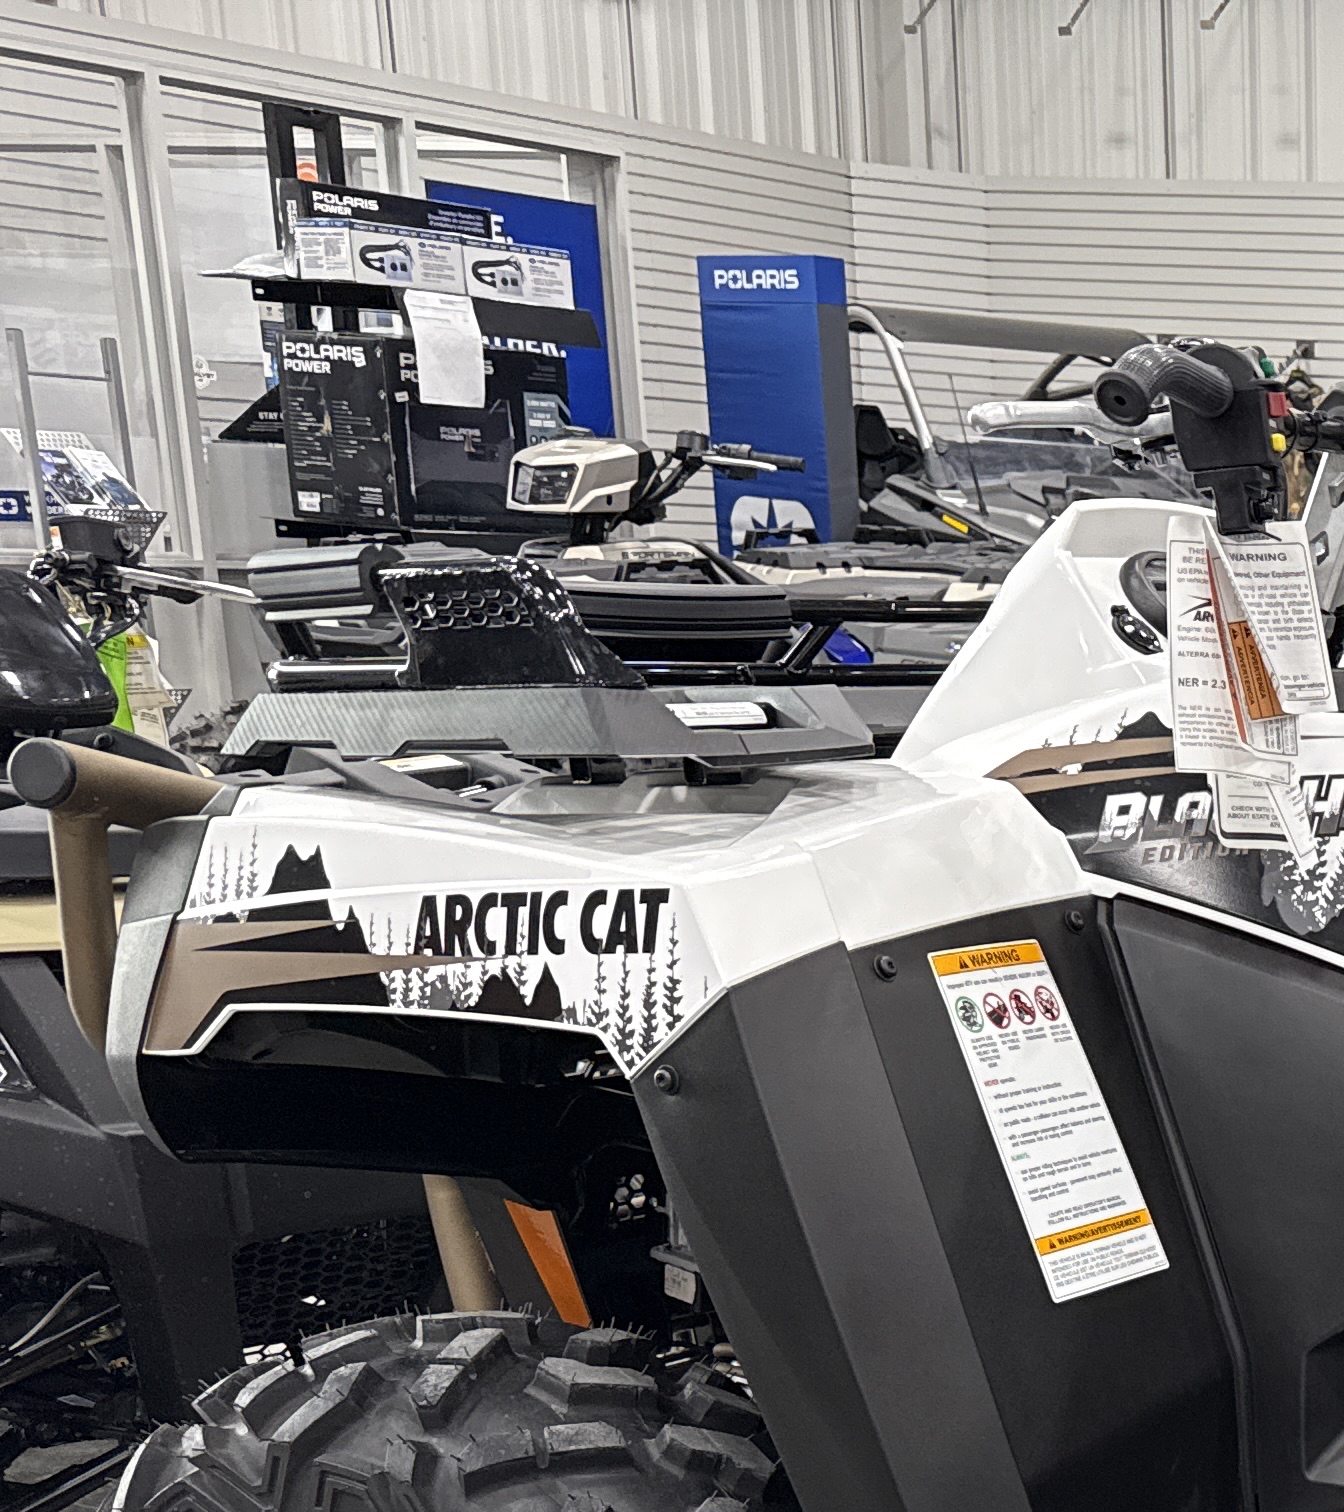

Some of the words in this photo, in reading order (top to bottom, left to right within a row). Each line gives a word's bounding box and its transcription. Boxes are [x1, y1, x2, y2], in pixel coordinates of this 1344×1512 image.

[311, 190, 379, 211] POLARIS
[313, 202, 352, 216] POWER
[713, 269, 800, 291] POLARIS
[282, 341, 365, 361] POLARIS
[284, 357, 331, 374] POWER
[1229, 552, 1288, 562] WARNING
[1178, 650, 1210, 659] ALTERRA
[1178, 678, 1199, 687] NER
[1211, 679, 1226, 690] 2.3
[413, 889, 569, 955] ARCTIC
[581, 887, 670, 955] CAT
[968, 948, 1021, 967] WARNING
